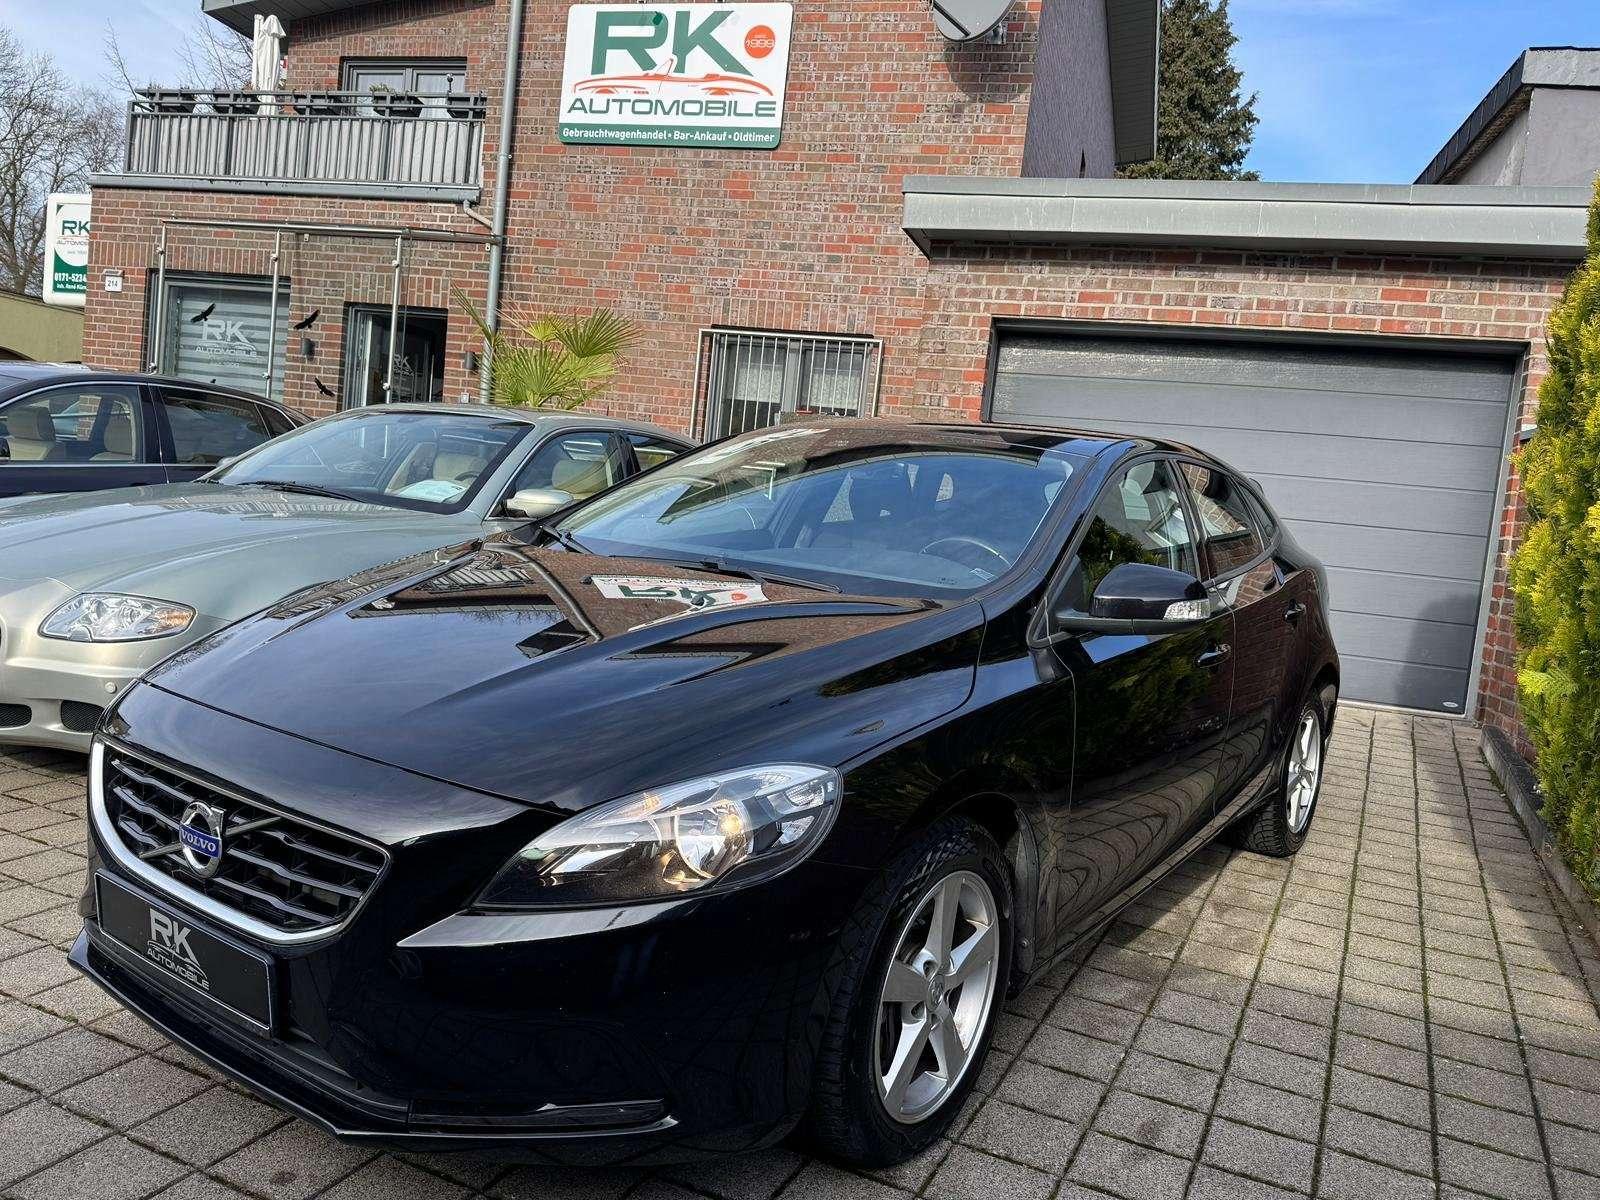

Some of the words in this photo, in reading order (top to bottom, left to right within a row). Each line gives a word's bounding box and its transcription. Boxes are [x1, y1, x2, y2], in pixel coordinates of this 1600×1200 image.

[590, 10, 754, 77] RK
[745, 39, 775, 48] 1999
[567, 97, 777, 118] AUTOMOBILE
[562, 127, 667, 141] Gebrauchtwagenhandel
[673, 130, 727, 142] Bar-Ankauf
[733, 132, 775, 143] Oldtimer
[62, 220, 90, 235] RK
[201, 319, 251, 344] RK
[180, 830, 217, 853] VOLVO
[149, 907, 199, 965] RK
[146, 947, 210, 992] AUTOMOBILE
